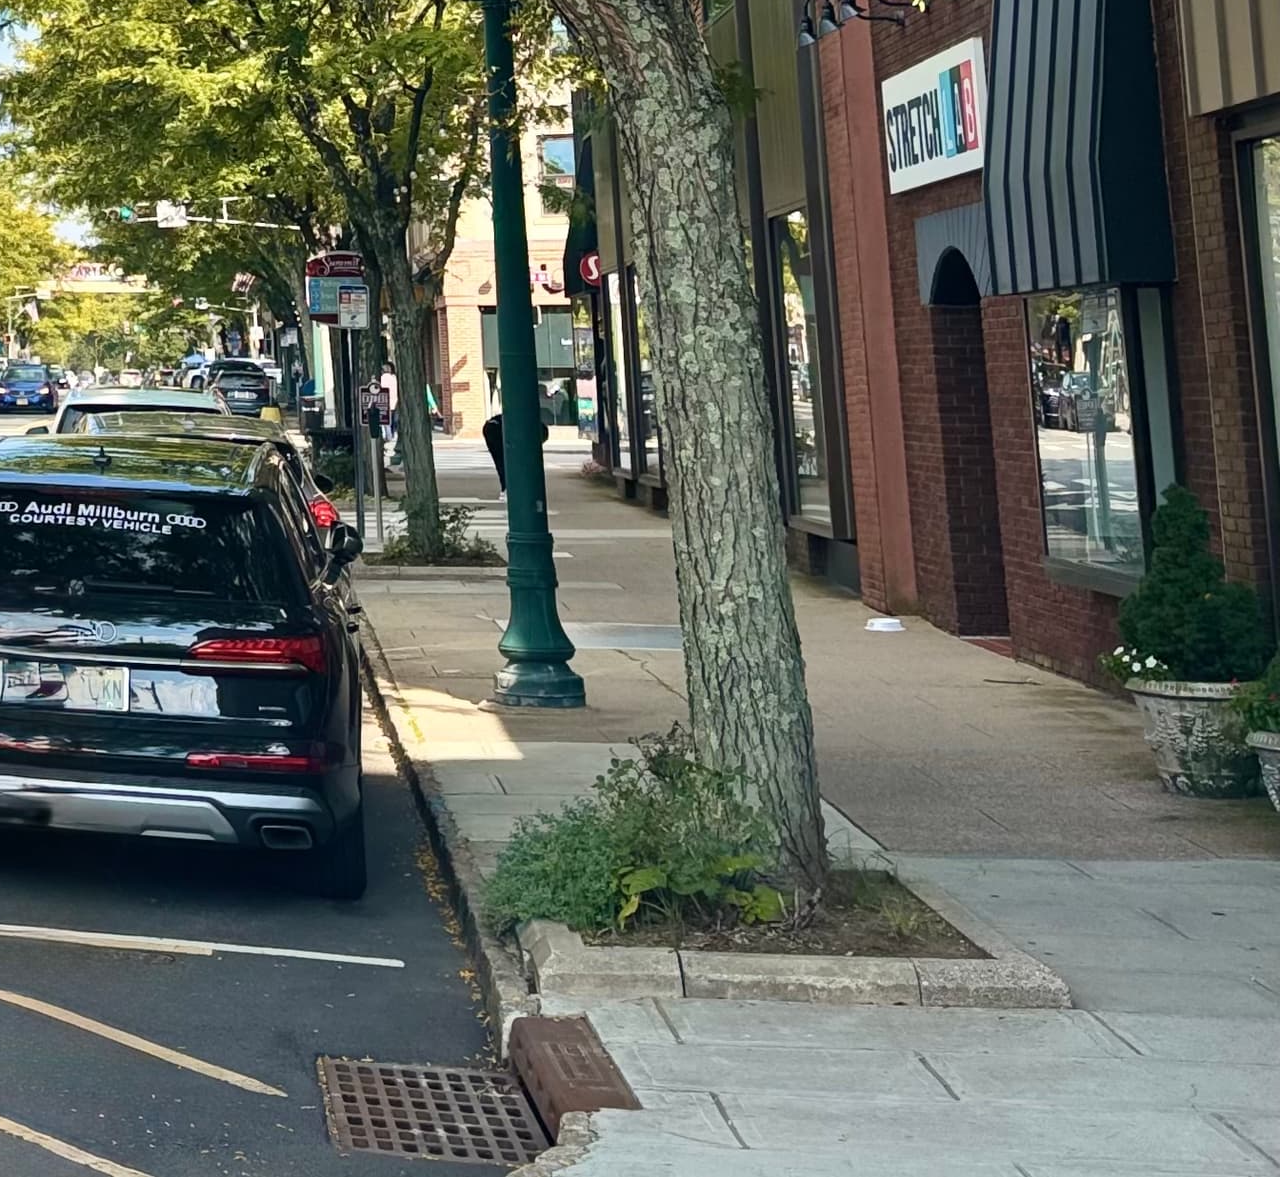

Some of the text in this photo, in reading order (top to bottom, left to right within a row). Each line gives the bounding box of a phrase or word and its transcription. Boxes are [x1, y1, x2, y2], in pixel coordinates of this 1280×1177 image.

[24, 501, 160, 523] Audi Millburn
[9, 513, 172, 535] COURTESY VEHICLE
